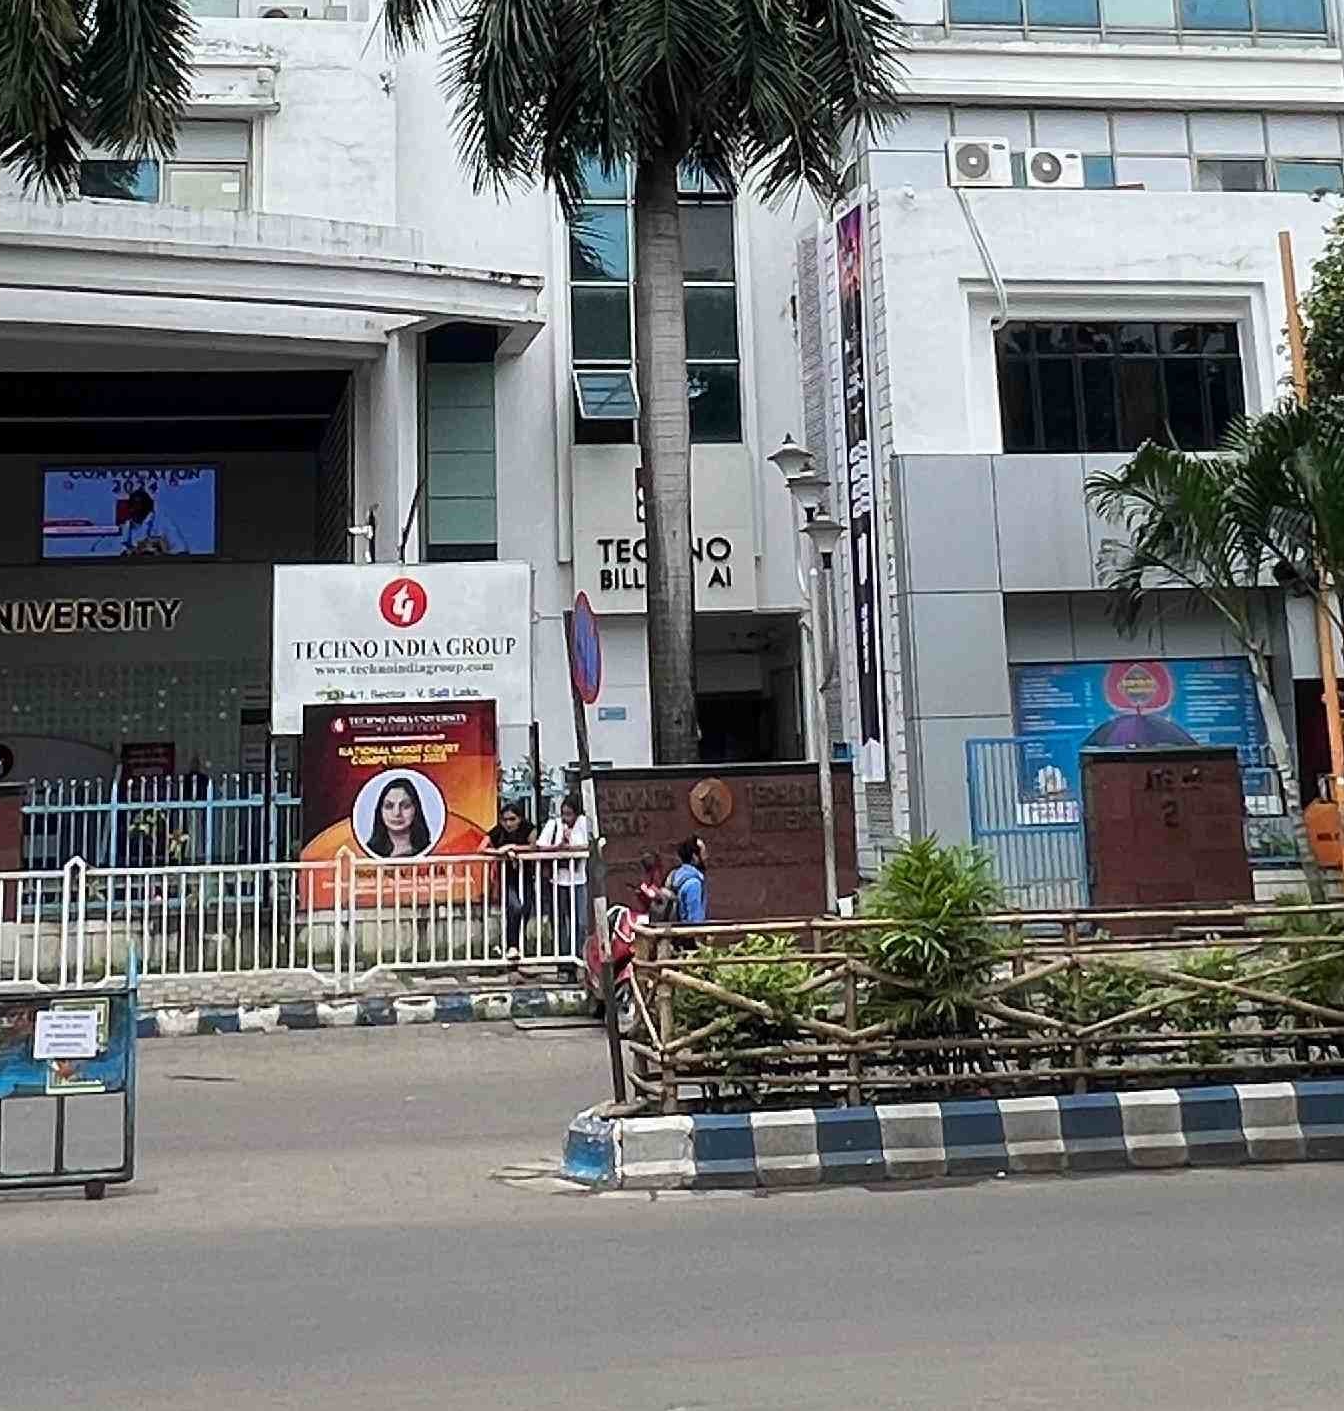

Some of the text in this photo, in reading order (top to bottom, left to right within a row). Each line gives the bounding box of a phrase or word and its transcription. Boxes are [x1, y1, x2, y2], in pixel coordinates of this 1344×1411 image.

[597, 537, 732, 564] TECNO
[292, 637, 516, 660] TECHNO INDIA GROUP
[314, 661, 494, 676] www.technoindiagroup.com
